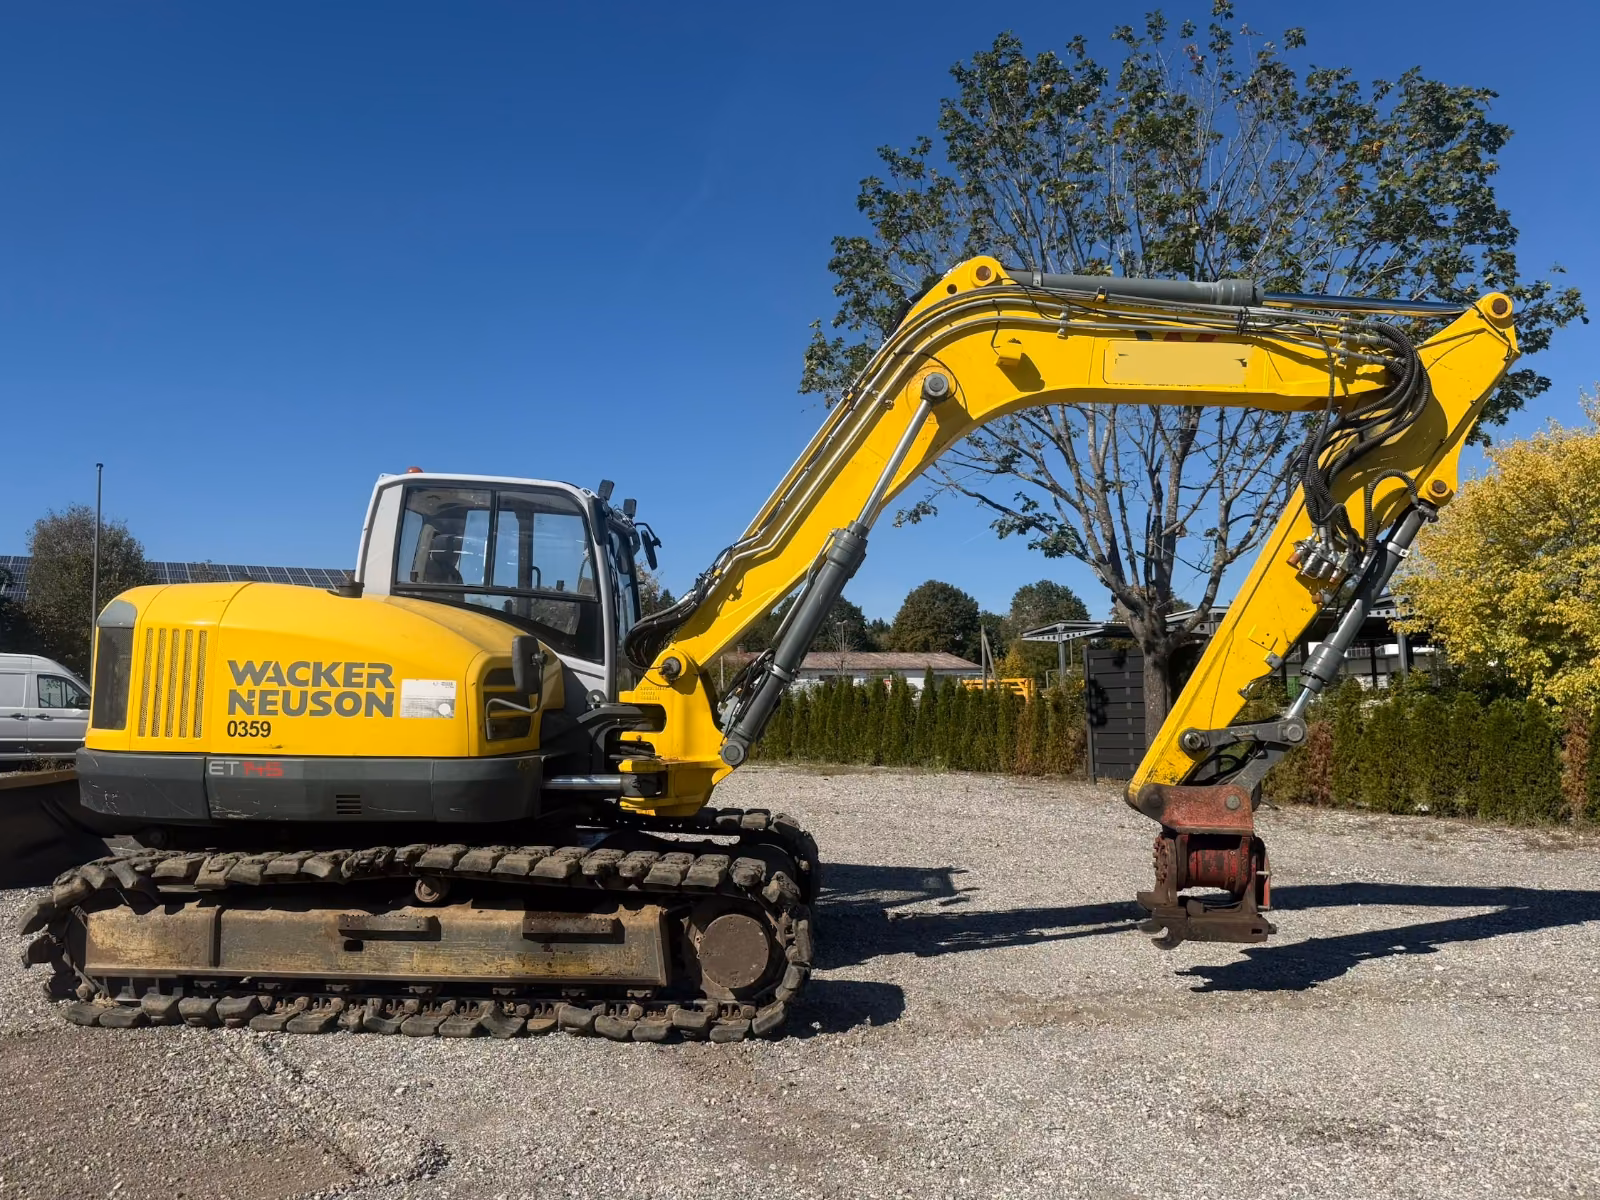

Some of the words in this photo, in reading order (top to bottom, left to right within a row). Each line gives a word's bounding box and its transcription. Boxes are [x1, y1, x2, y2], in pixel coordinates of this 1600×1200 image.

[227, 660, 395, 688] WACKER
[227, 689, 395, 718] NEUSON
[227, 720, 272, 738] 0359
[208, 761, 240, 776] ET
